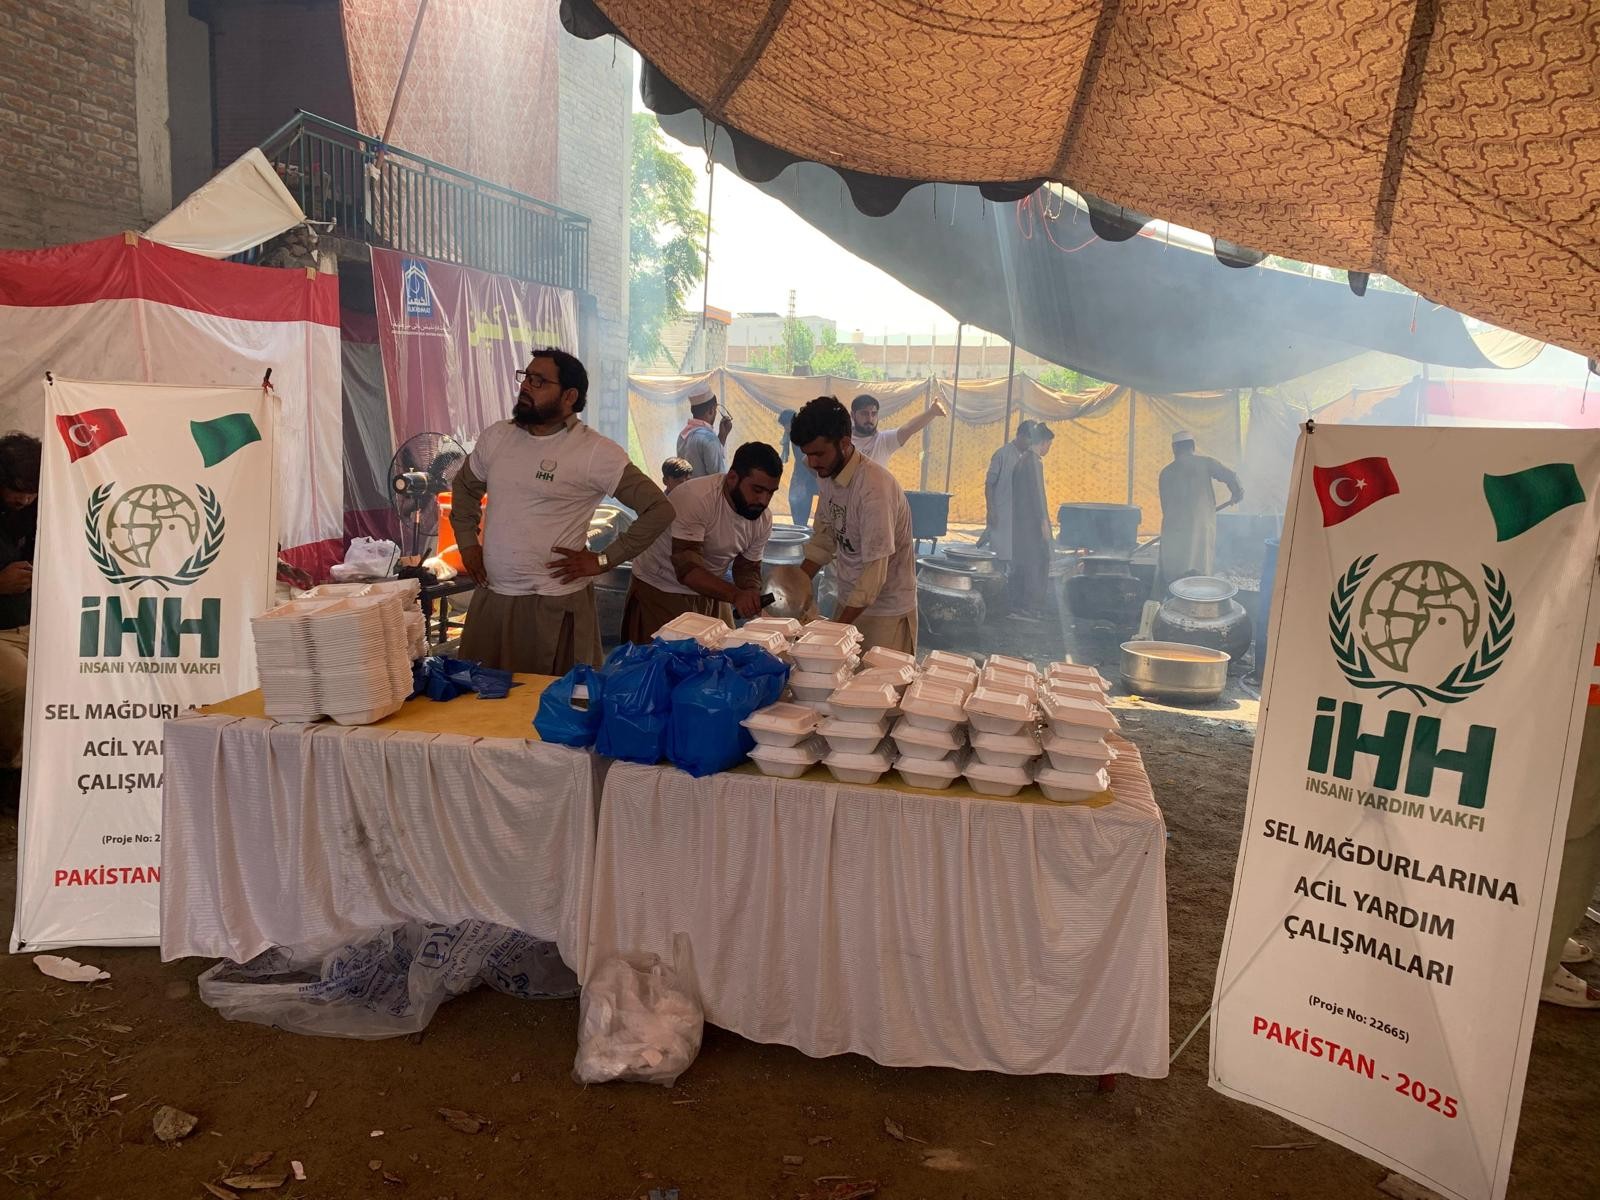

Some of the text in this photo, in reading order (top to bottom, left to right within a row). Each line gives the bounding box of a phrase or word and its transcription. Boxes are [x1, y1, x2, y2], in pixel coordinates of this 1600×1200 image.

[127, 661, 177, 675] YARDIM
[180, 662, 221, 676] VAKFI
[44, 703, 80, 720] SEL
[83, 737, 163, 757] ACİL YA
[1357, 789, 1425, 820] YARDIM
[1429, 805, 1486, 833] VAKFI
[102, 835, 133, 846] (Proje
[135, 834, 153, 844] No:
[54, 864, 161, 887] PAKİSTAN
[1263, 818, 1519, 905] SEL MAĞDURLARINA
[1294, 876, 1455, 940] ACİL YARDIM
[1284, 915, 1454, 986] ÇALIŞMALARI
[1309, 995, 1344, 1015] (Proje
[1346, 1008, 1367, 1025] No:
[1253, 1016, 1375, 1079] PAKİSTAN
[1395, 1072, 1458, 1119] 2025
